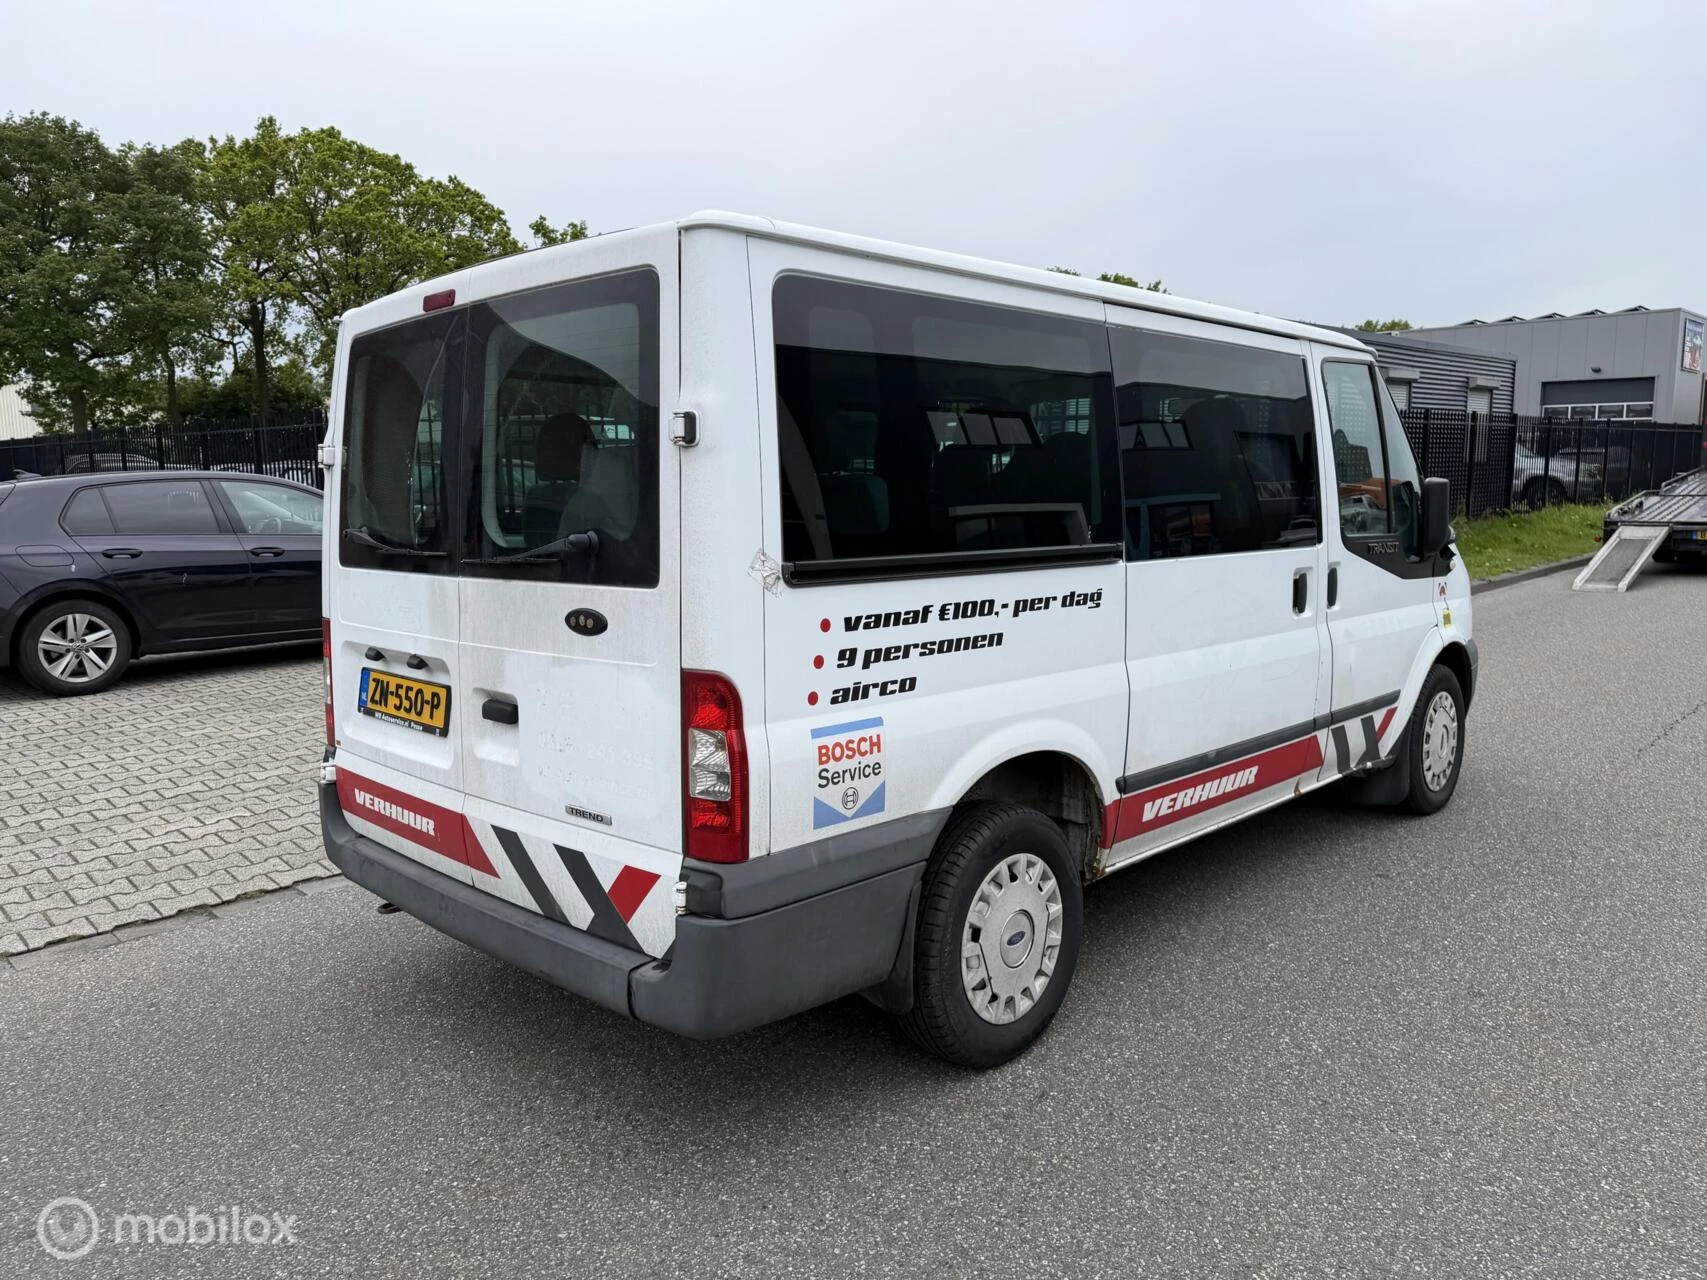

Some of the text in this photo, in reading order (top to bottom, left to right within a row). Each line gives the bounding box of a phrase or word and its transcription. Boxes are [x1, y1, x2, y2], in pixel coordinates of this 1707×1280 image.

[843, 588, 1103, 633] vanaf €100,- per dag
[836, 632, 1004, 671] 9 personen
[369, 677, 441, 720] ZN-550-P
[829, 676, 918, 706] airco
[817, 733, 882, 766] BOSCH
[817, 760, 883, 789] Service
[1141, 764, 1260, 823] VERHUUR
[353, 788, 436, 836] VERHUUR
[568, 806, 604, 823] TREND
